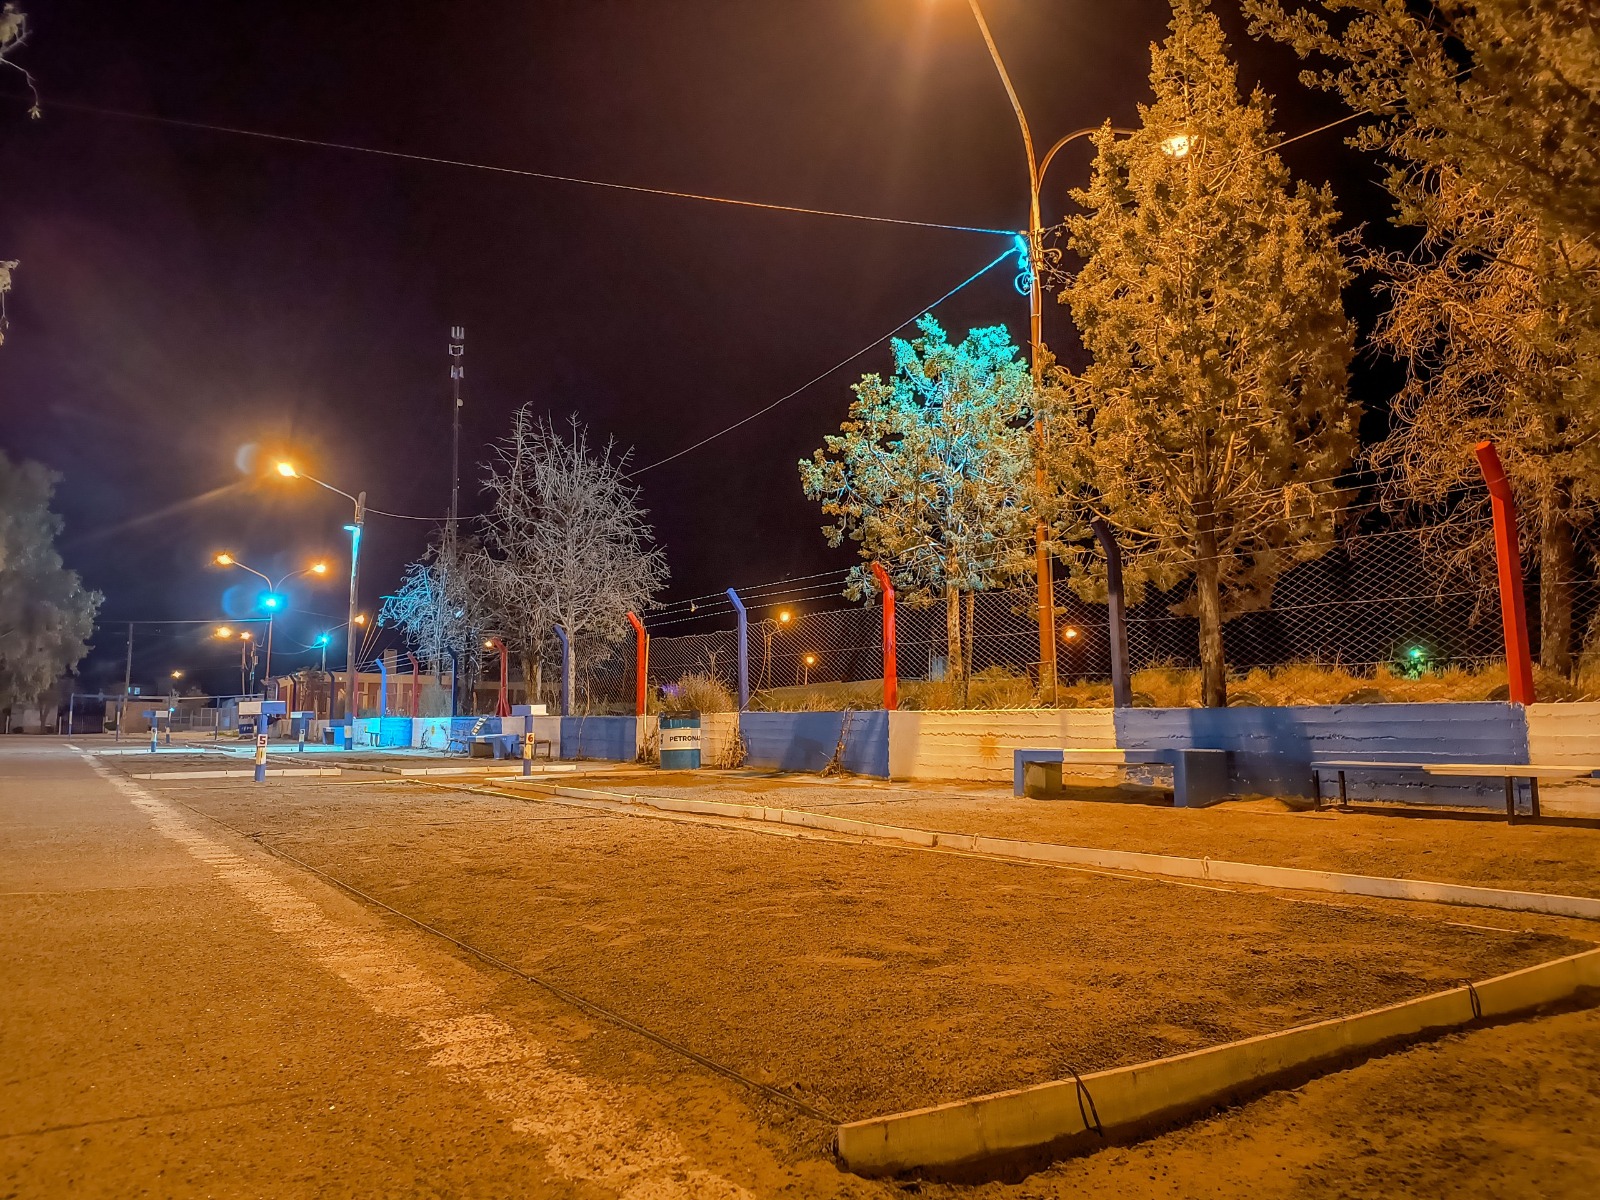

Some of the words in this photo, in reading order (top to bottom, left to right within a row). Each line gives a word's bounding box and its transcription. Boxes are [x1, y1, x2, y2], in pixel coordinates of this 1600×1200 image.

[259, 735, 266, 745] 5
[527, 734, 534, 743] 6
[669, 735, 701, 743] PETRONA
